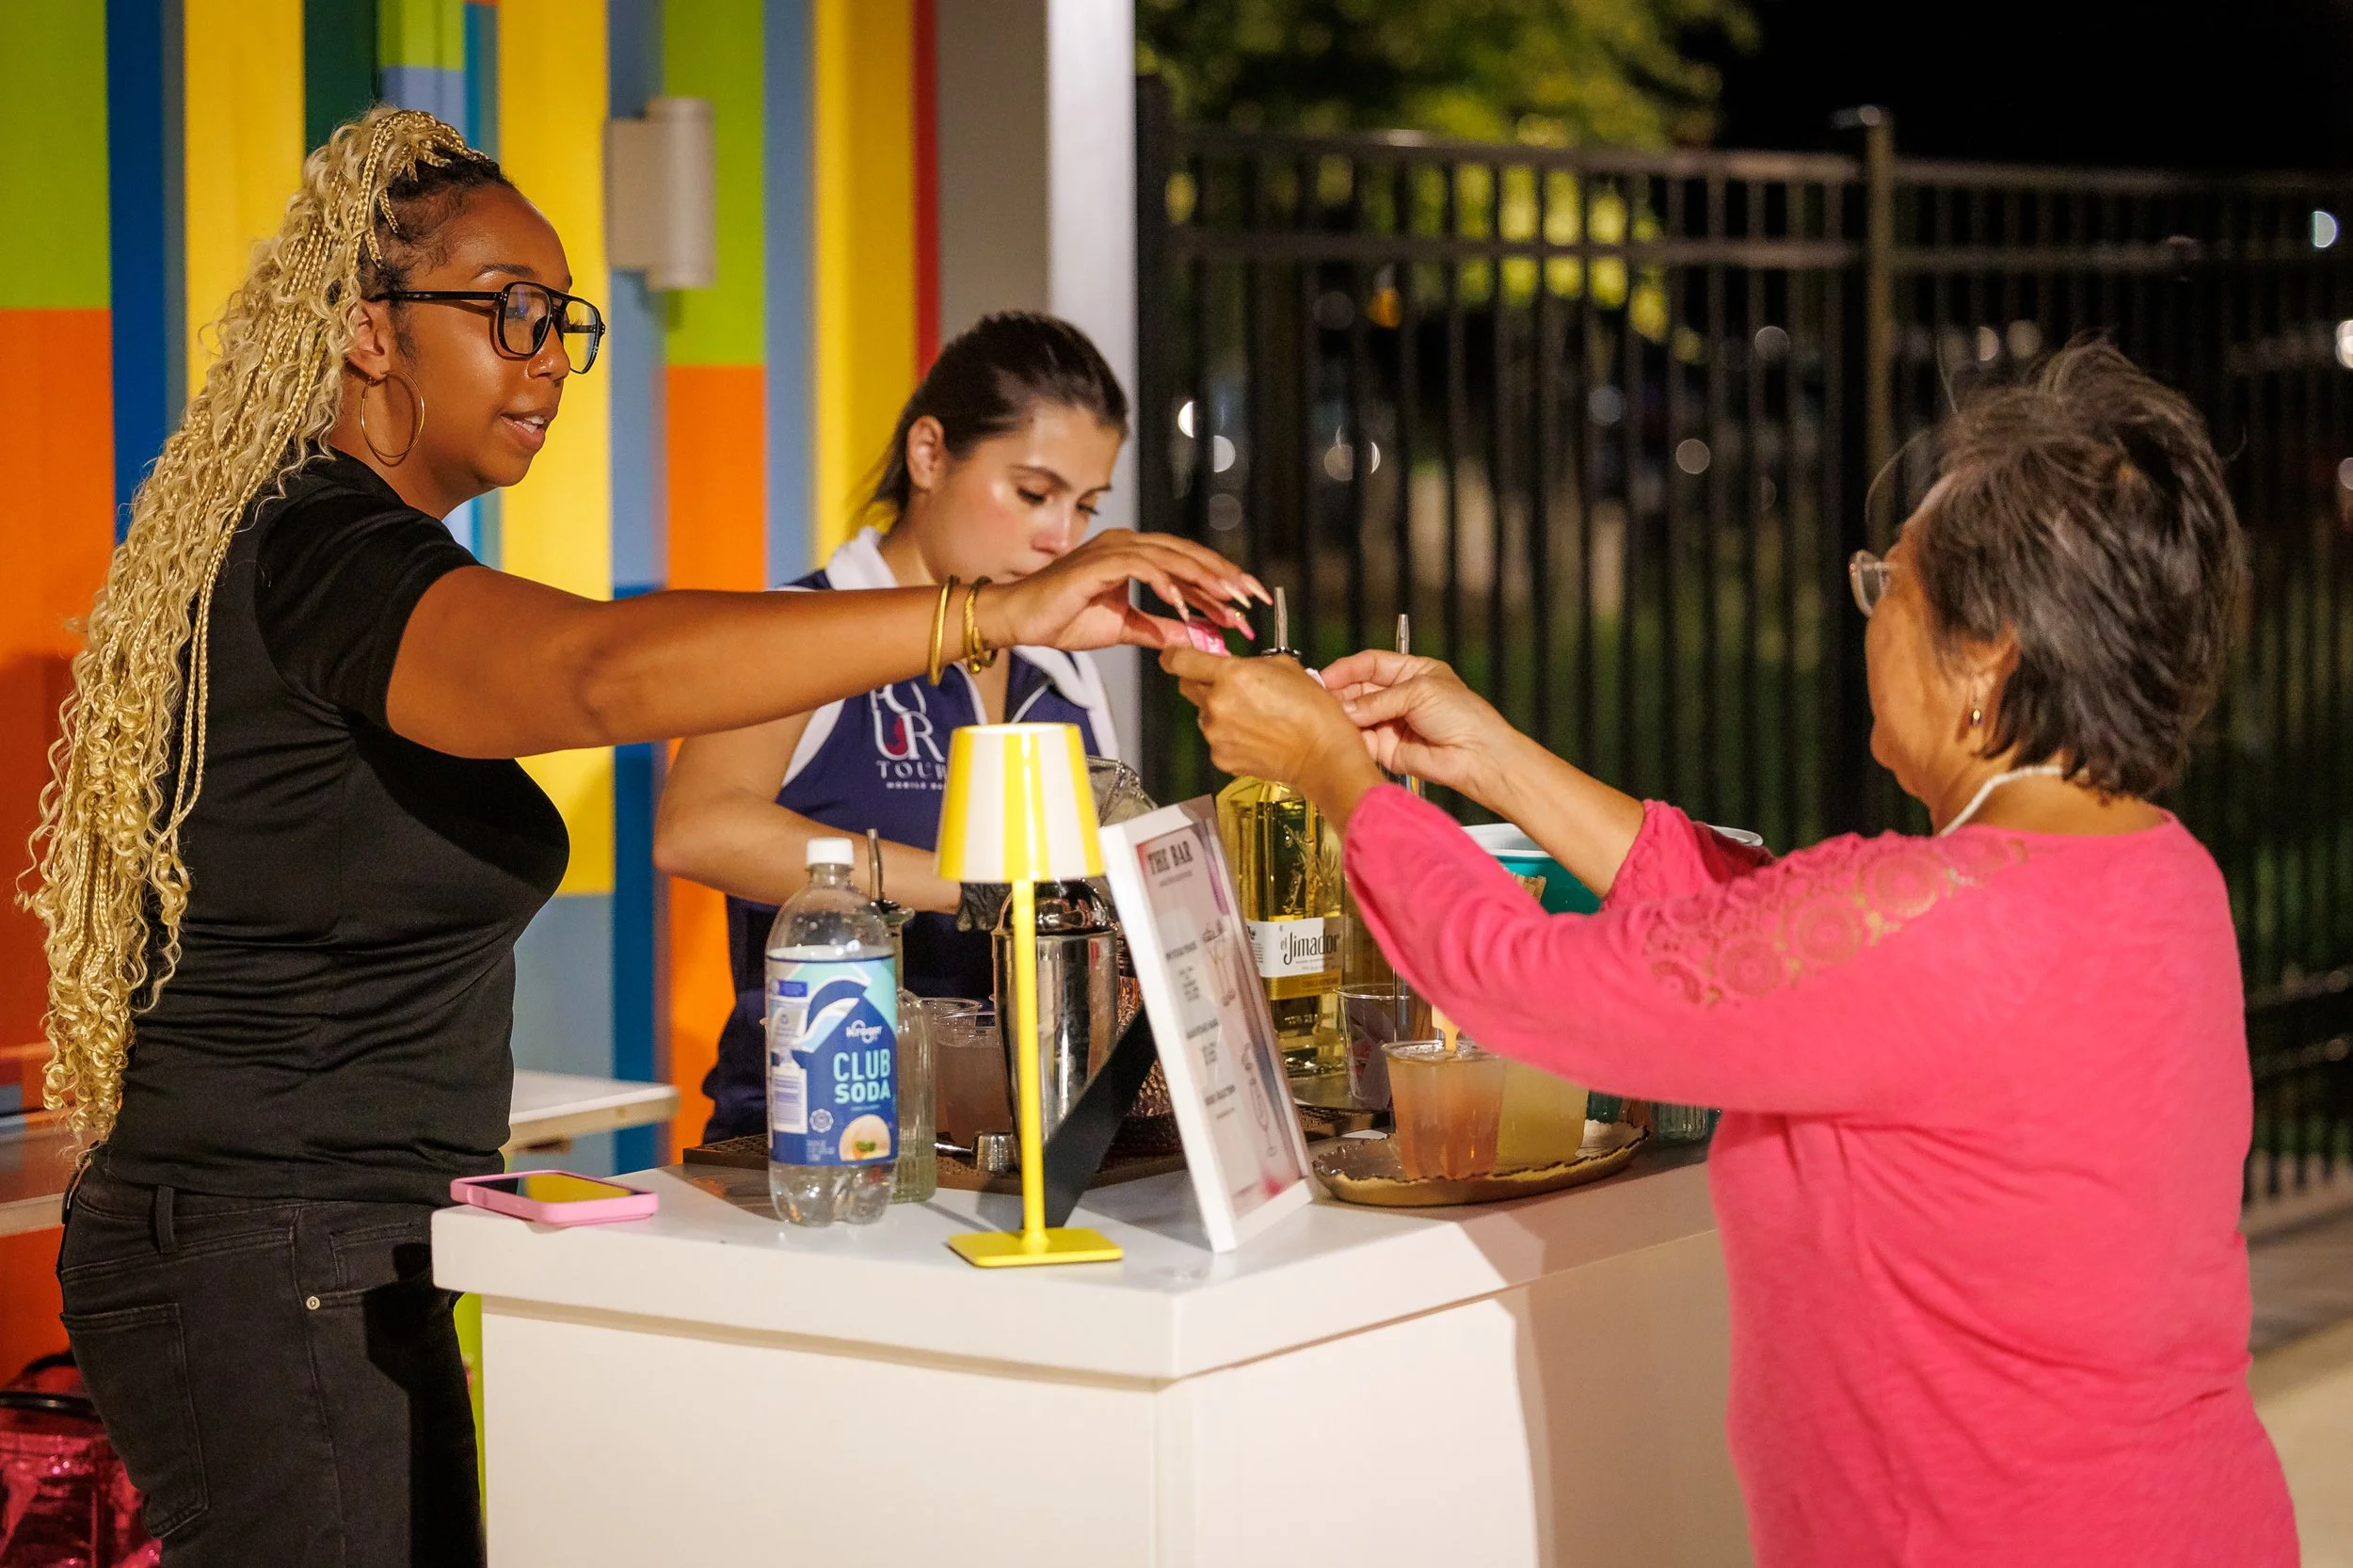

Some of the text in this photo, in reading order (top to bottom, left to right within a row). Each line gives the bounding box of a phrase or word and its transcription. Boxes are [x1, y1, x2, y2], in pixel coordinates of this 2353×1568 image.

[1147, 840, 1193, 875] THE BAR
[1283, 928, 1340, 966] Jimador
[833, 1048, 891, 1082] CLUB
[834, 1079, 891, 1104] SODA
